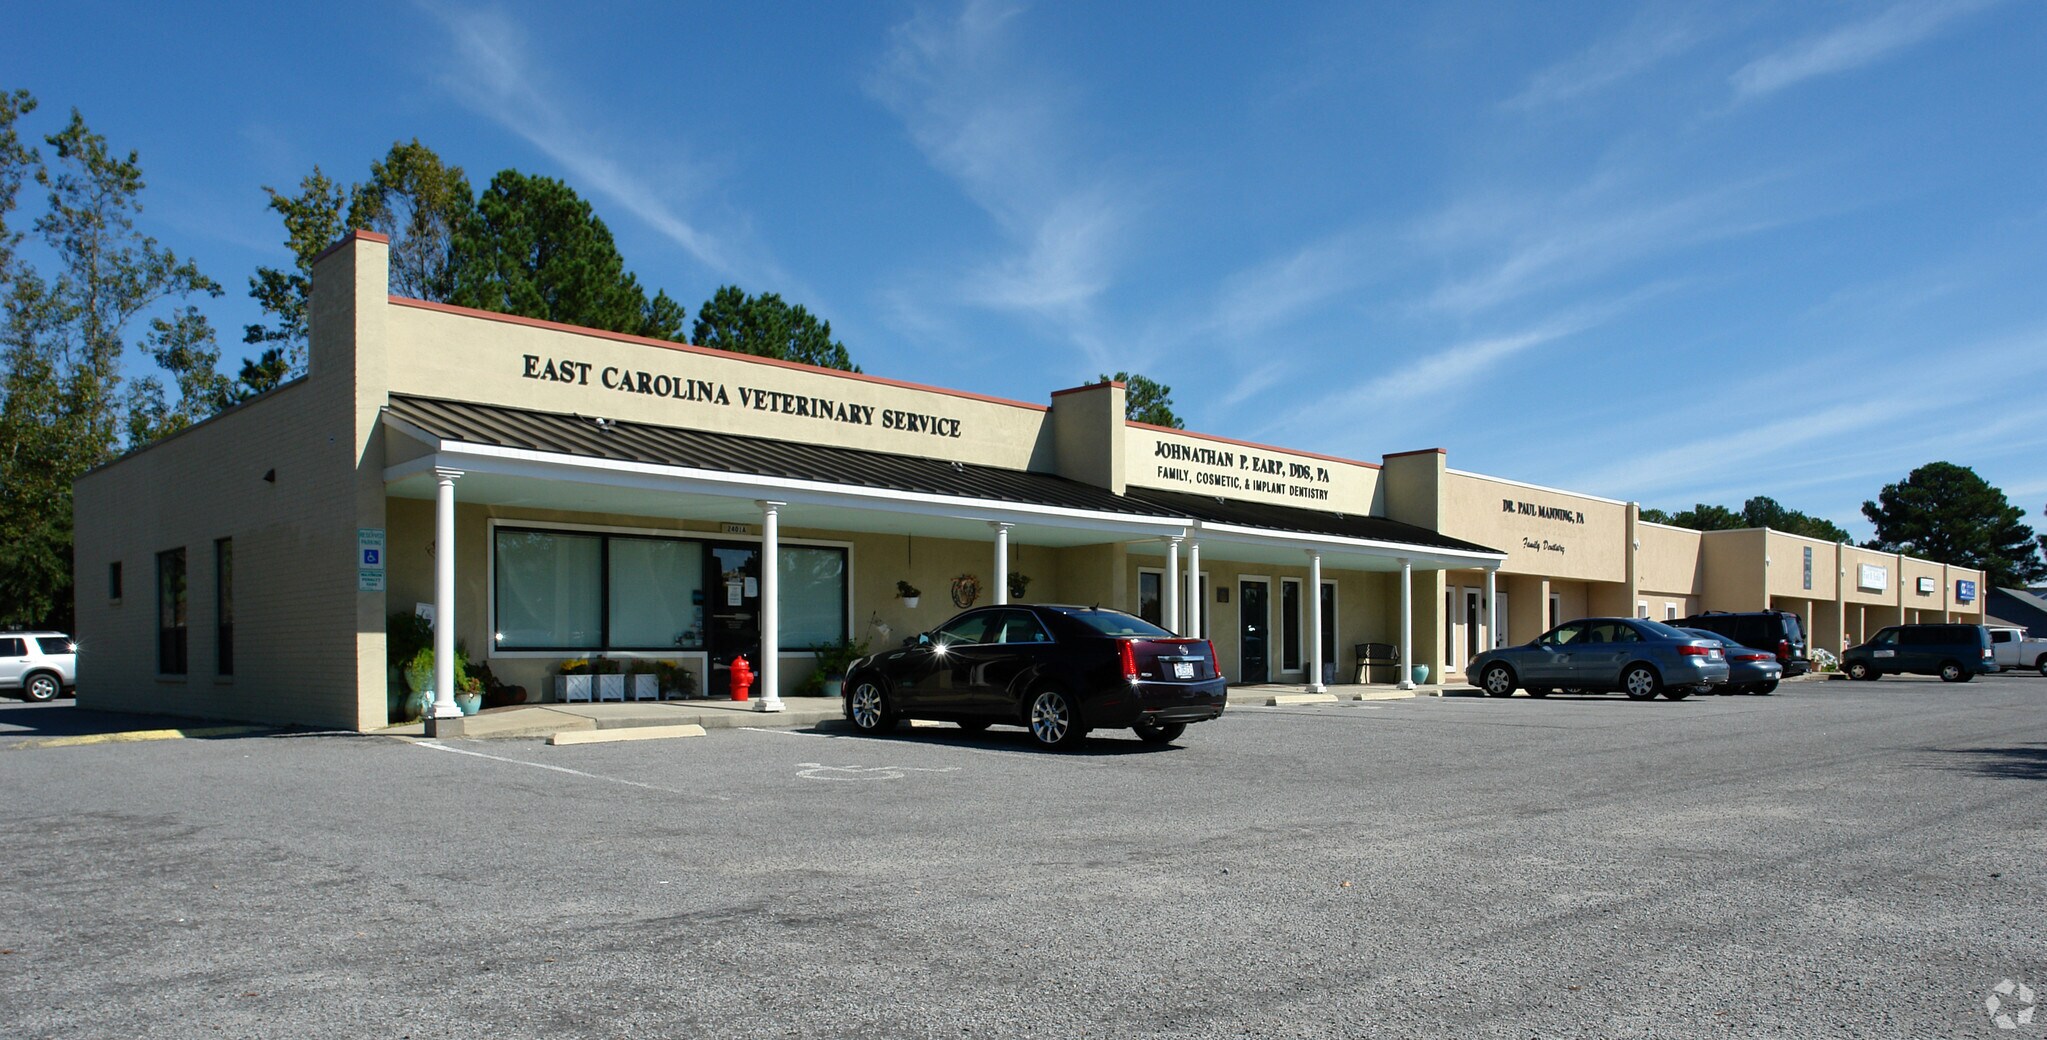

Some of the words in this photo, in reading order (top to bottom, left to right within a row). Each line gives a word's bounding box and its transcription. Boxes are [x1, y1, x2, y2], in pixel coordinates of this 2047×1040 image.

[523, 354, 592, 386] EAST
[601, 366, 730, 406] CAROLINA
[738, 386, 876, 426] VETERINARY
[882, 409, 961, 439] SERVICE
[1154, 441, 1233, 467] JOHNATHAN
[1239, 454, 1249, 471] P.
[1252, 456, 1286, 477] EARP,
[1289, 462, 1314, 482] DDS,
[1317, 466, 1330, 483] PA
[1157, 466, 1192, 484] FAMILY,
[1196, 471, 1242, 490] COSMETIC,
[1244, 478, 1250, 490] &
[1253, 479, 1286, 496] IMPLANT
[1289, 485, 1329, 500] DENTISTRY
[1502, 499, 1515, 513] DR.
[1517, 502, 1537, 516] PAUL
[1538, 505, 1575, 524] MANNING,
[1576, 512, 1584, 524] PA
[1522, 537, 1541, 552] Family
